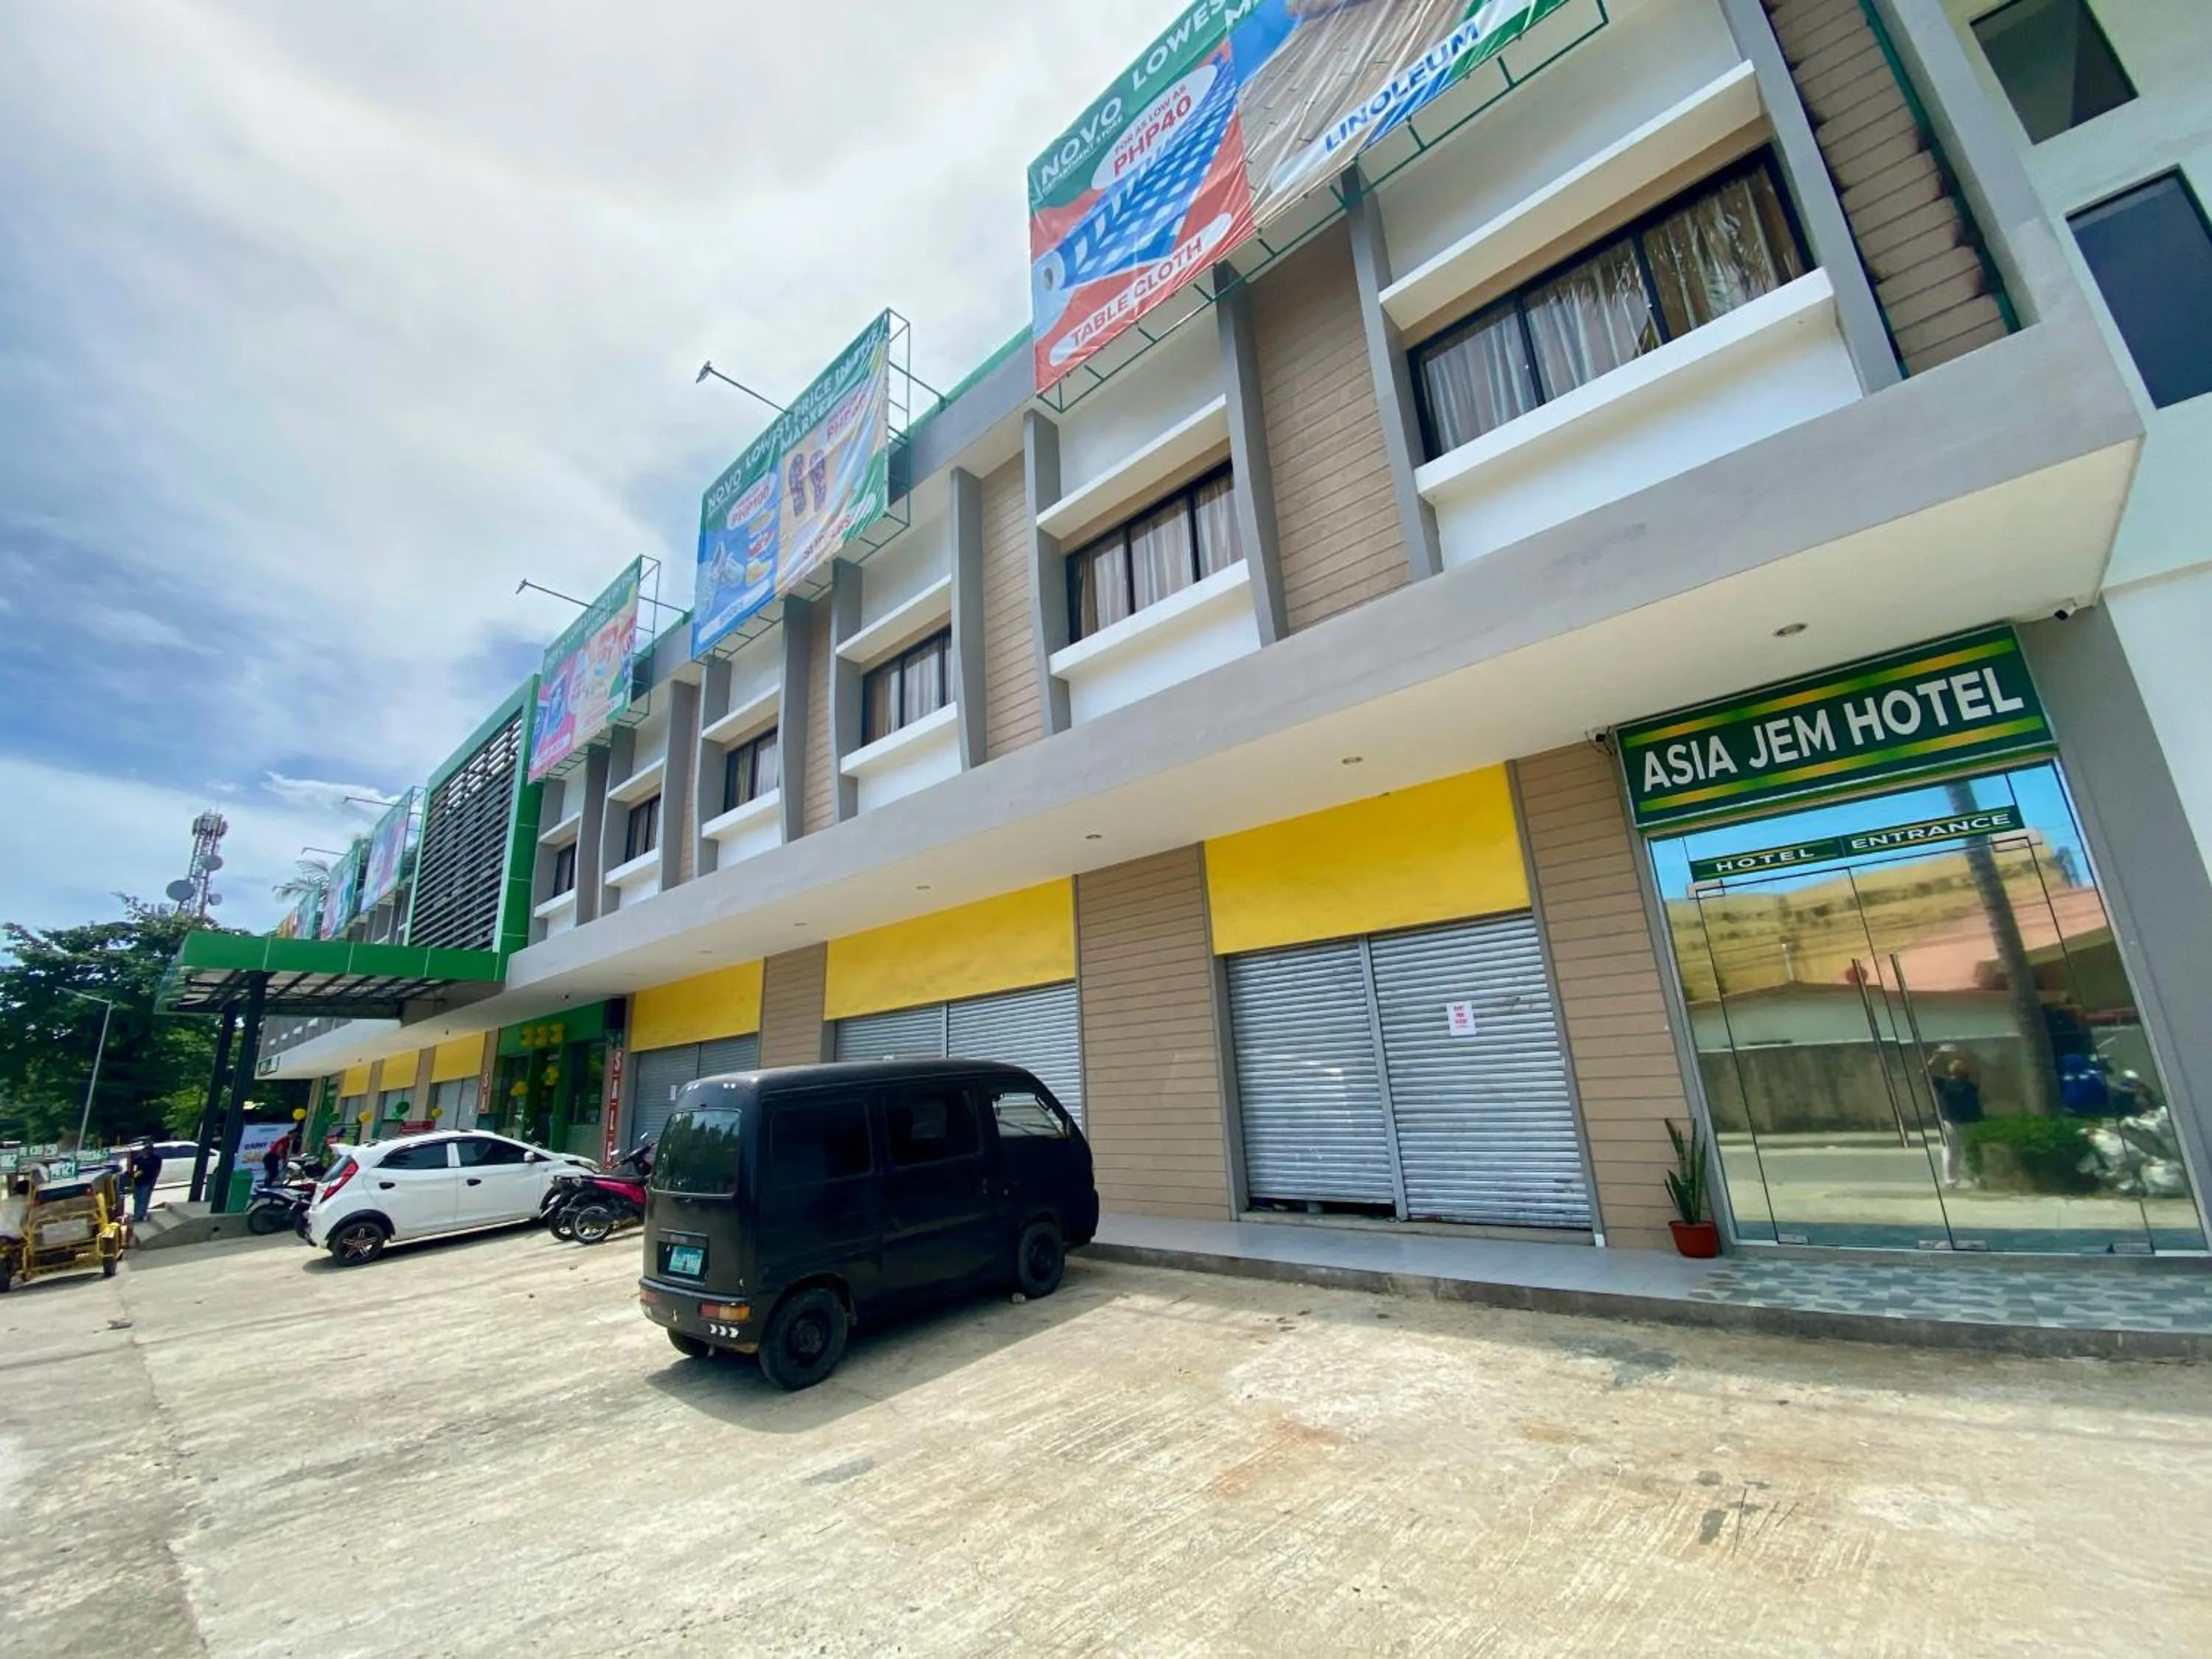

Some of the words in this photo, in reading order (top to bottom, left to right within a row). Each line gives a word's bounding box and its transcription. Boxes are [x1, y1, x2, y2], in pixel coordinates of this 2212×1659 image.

[1114, 132, 1134, 153] FOR
[1135, 119, 1148, 135] AS
[1149, 97, 1171, 122] LOW
[1172, 84, 1186, 101] AS
[1324, 21, 1481, 153] LINOLEUM
[1041, 97, 1121, 185] NOVO
[1113, 94, 1192, 178] PHP40
[1071, 293, 1130, 347] TABLE
[1133, 236, 1203, 299] CLOTH
[707, 470, 741, 512] NOVO
[793, 375, 832, 422] PRICE
[779, 394, 835, 451] MARKET
[1644, 735, 1738, 792] ASIA
[1748, 708, 1837, 769] JEM
[1844, 667, 2025, 746] HOTEL
[1716, 848, 1815, 872] HOTEL
[1851, 813, 2011, 850] ENTRANCE
